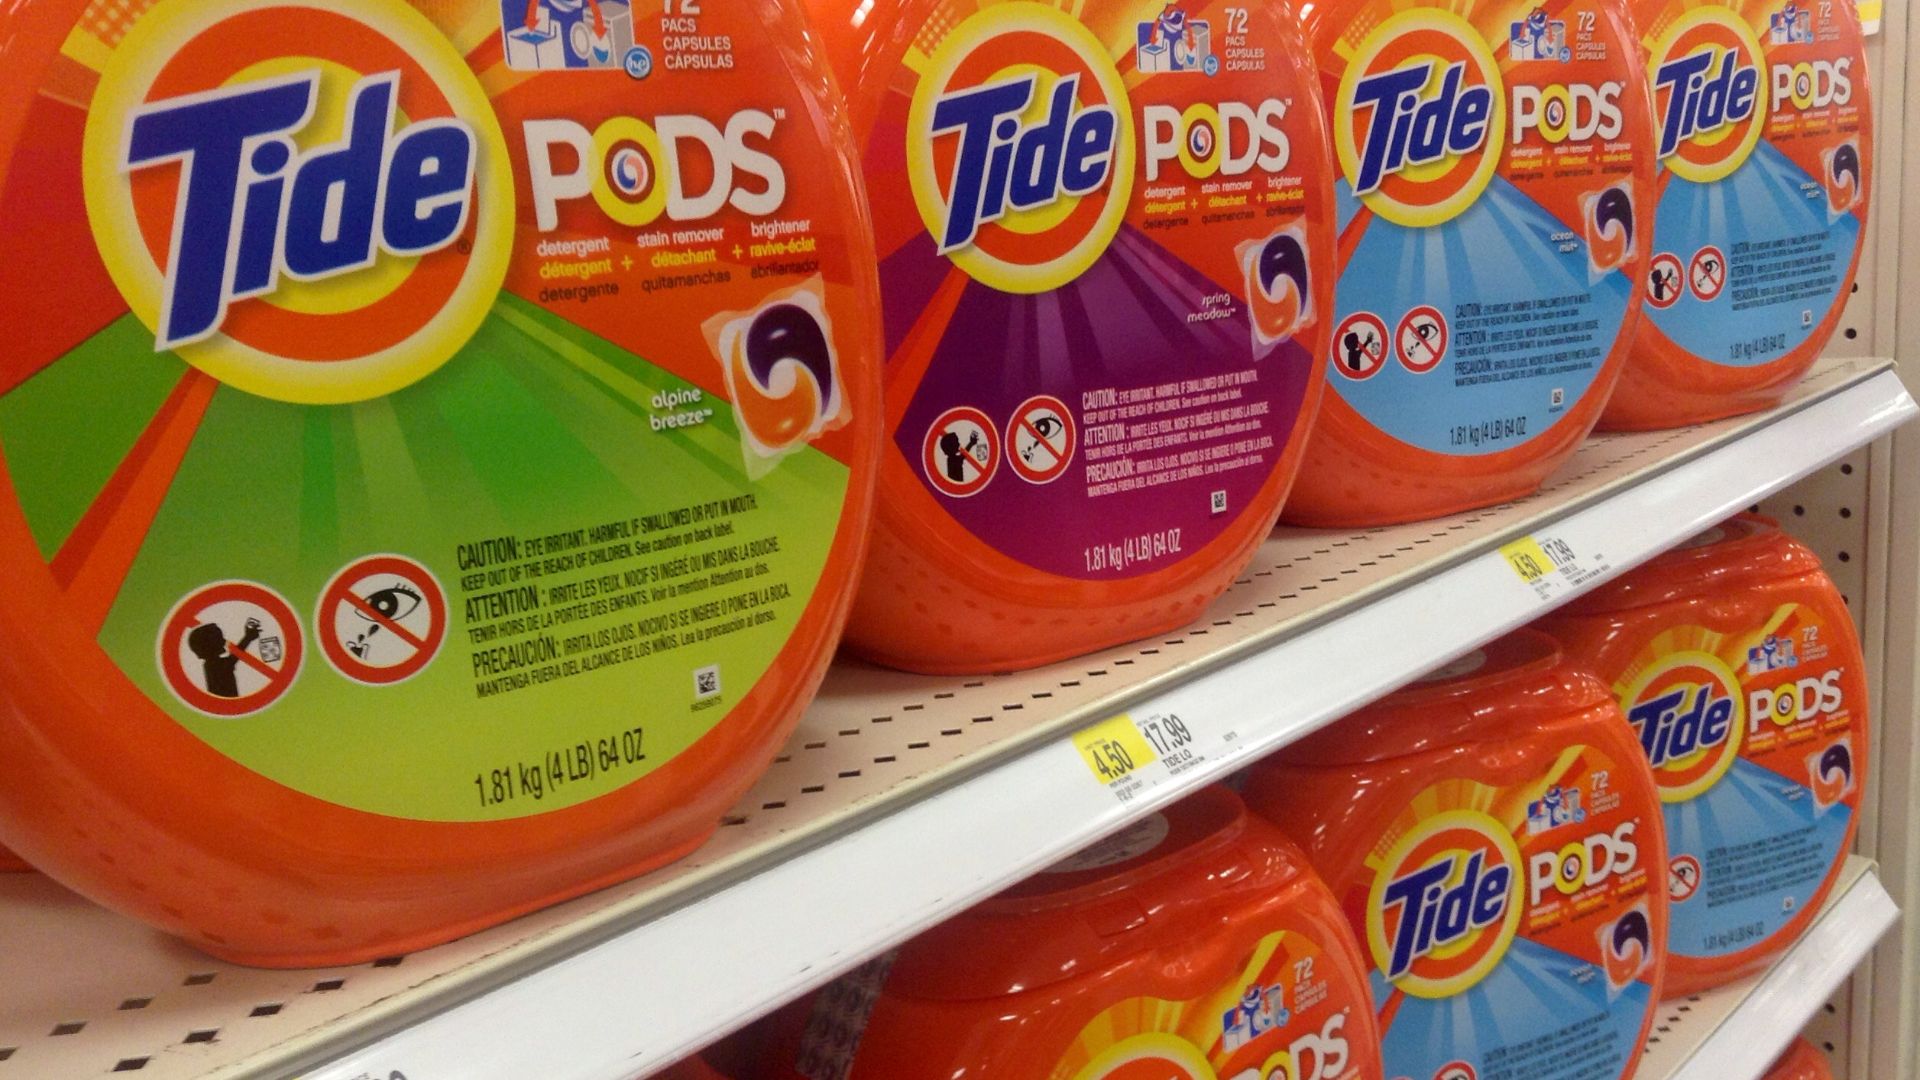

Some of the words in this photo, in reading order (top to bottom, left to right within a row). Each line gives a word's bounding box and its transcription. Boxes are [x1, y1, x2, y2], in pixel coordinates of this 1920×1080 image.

[661, 18, 696, 33] PACS
[1225, 8, 1248, 34] 72
[1577, 12, 1595, 32] 72
[663, 36, 731, 51] CAPSULES
[665, 52, 733, 69] CÁPSULAS
[1225, 36, 1245, 46] PACS
[1225, 48, 1264, 59] CAPSULES
[1655, 47, 1758, 160] Tide
[1352, 60, 1493, 197] Tide
[930, 72, 1118, 256] Tide
[1144, 186, 1186, 200] detergent
[1202, 182, 1220, 194] stain
[1221, 180, 1253, 192] remover
[119, 67, 477, 353] Tide
[536, 235, 610, 258] detergent
[637, 232, 669, 248] stain
[672, 227, 724, 244] remover
[750, 218, 811, 239] brightener
[539, 257, 612, 281] détergent
[651, 248, 717, 268] détachant
[750, 238, 816, 259] ravive-éclat
[538, 283, 620, 305] detergente
[641, 270, 732, 293] quitamanchas
[1201, 292, 1231, 309] spring
[652, 388, 702, 411] alpine
[1082, 387, 1118, 411] CAUTION:
[1084, 422, 1125, 447] ATTENTION
[1450, 426, 1467, 446] 1.81
[1469, 425, 1480, 447] kg
[1480, 421, 1489, 444] (4
[1490, 418, 1503, 441] LB)
[1504, 419, 1515, 438] 64
[1516, 416, 1526, 436] OZ
[457, 536, 522, 571] CAUTION:
[526, 538, 543, 558] EYE
[545, 529, 588, 553] IRRITANT.
[588, 521, 631, 544] HARMFUL
[631, 517, 639, 536] IF
[641, 507, 692, 534] SWALLOWED
[692, 504, 704, 522] OR
[705, 501, 719, 519] PUT
[720, 499, 730, 516] IN
[1085, 546, 1106, 572] 1.81
[1108, 543, 1122, 571] kg
[1124, 537, 1135, 566] (4
[1135, 533, 1153, 560] LB)
[1153, 534, 1167, 556] 64
[1168, 527, 1181, 554] OZ
[461, 573, 486, 592] KEEP
[488, 568, 507, 587] OUT
[509, 565, 523, 582] OF
[523, 561, 543, 578] THE
[544, 553, 575, 575] REACH
[575, 551, 588, 569] OF
[588, 541, 635, 566] CHILDREN.
[635, 540, 652, 556] See
[652, 534, 683, 551] caution
[683, 532, 695, 546] on
[694, 525, 714, 543] back
[466, 585, 540, 623] ATTENTION
[549, 583, 579, 605] IRRITE
[579, 578, 598, 599] LES
[624, 567, 650, 588] NOCIF
[649, 565, 660, 582] SI
[690, 553, 703, 574] OU
[702, 551, 718, 571] MIS
[718, 545, 739, 566] DANS
[739, 543, 750, 562] LA
[468, 625, 498, 645] TENIR
[498, 617, 526, 639] HORS
[526, 613, 541, 632] DE
[541, 610, 554, 629] LA
[590, 599, 609, 618] DES
[472, 632, 561, 679] PRECAUCIÓN:
[563, 633, 594, 656] IRRITA
[592, 629, 611, 649] LOS
[637, 614, 669, 638] NOCIVO
[679, 609, 690, 628] SE
[728, 593, 749, 613] PONE
[749, 590, 760, 608] EN
[760, 587, 770, 606] LA
[1803, 625, 1818, 642] 72
[476, 671, 530, 699] MANTENGA
[530, 663, 562, 686] FUERA
[561, 659, 581, 677] DEL
[581, 648, 622, 673] ALCANCE
[621, 645, 635, 663] DE
[634, 641, 652, 659] LOS
[680, 631, 696, 647] Lea
[1143, 713, 1192, 755] 17.99
[1628, 682, 1735, 770] Tide
[474, 765, 514, 807] 1.81
[518, 762, 544, 800] kg
[545, 751, 564, 793] (4
[565, 740, 595, 781] LB)
[598, 735, 619, 773] 64
[623, 727, 646, 765] OZ
[1092, 740, 1134, 779] 4.50
[1162, 753, 1182, 769] TIDE
[1591, 770, 1608, 791] 72
[1383, 847, 1513, 982] Tide
[1294, 956, 1314, 983] 72
[1229, 1012, 1349, 1080] ODS
